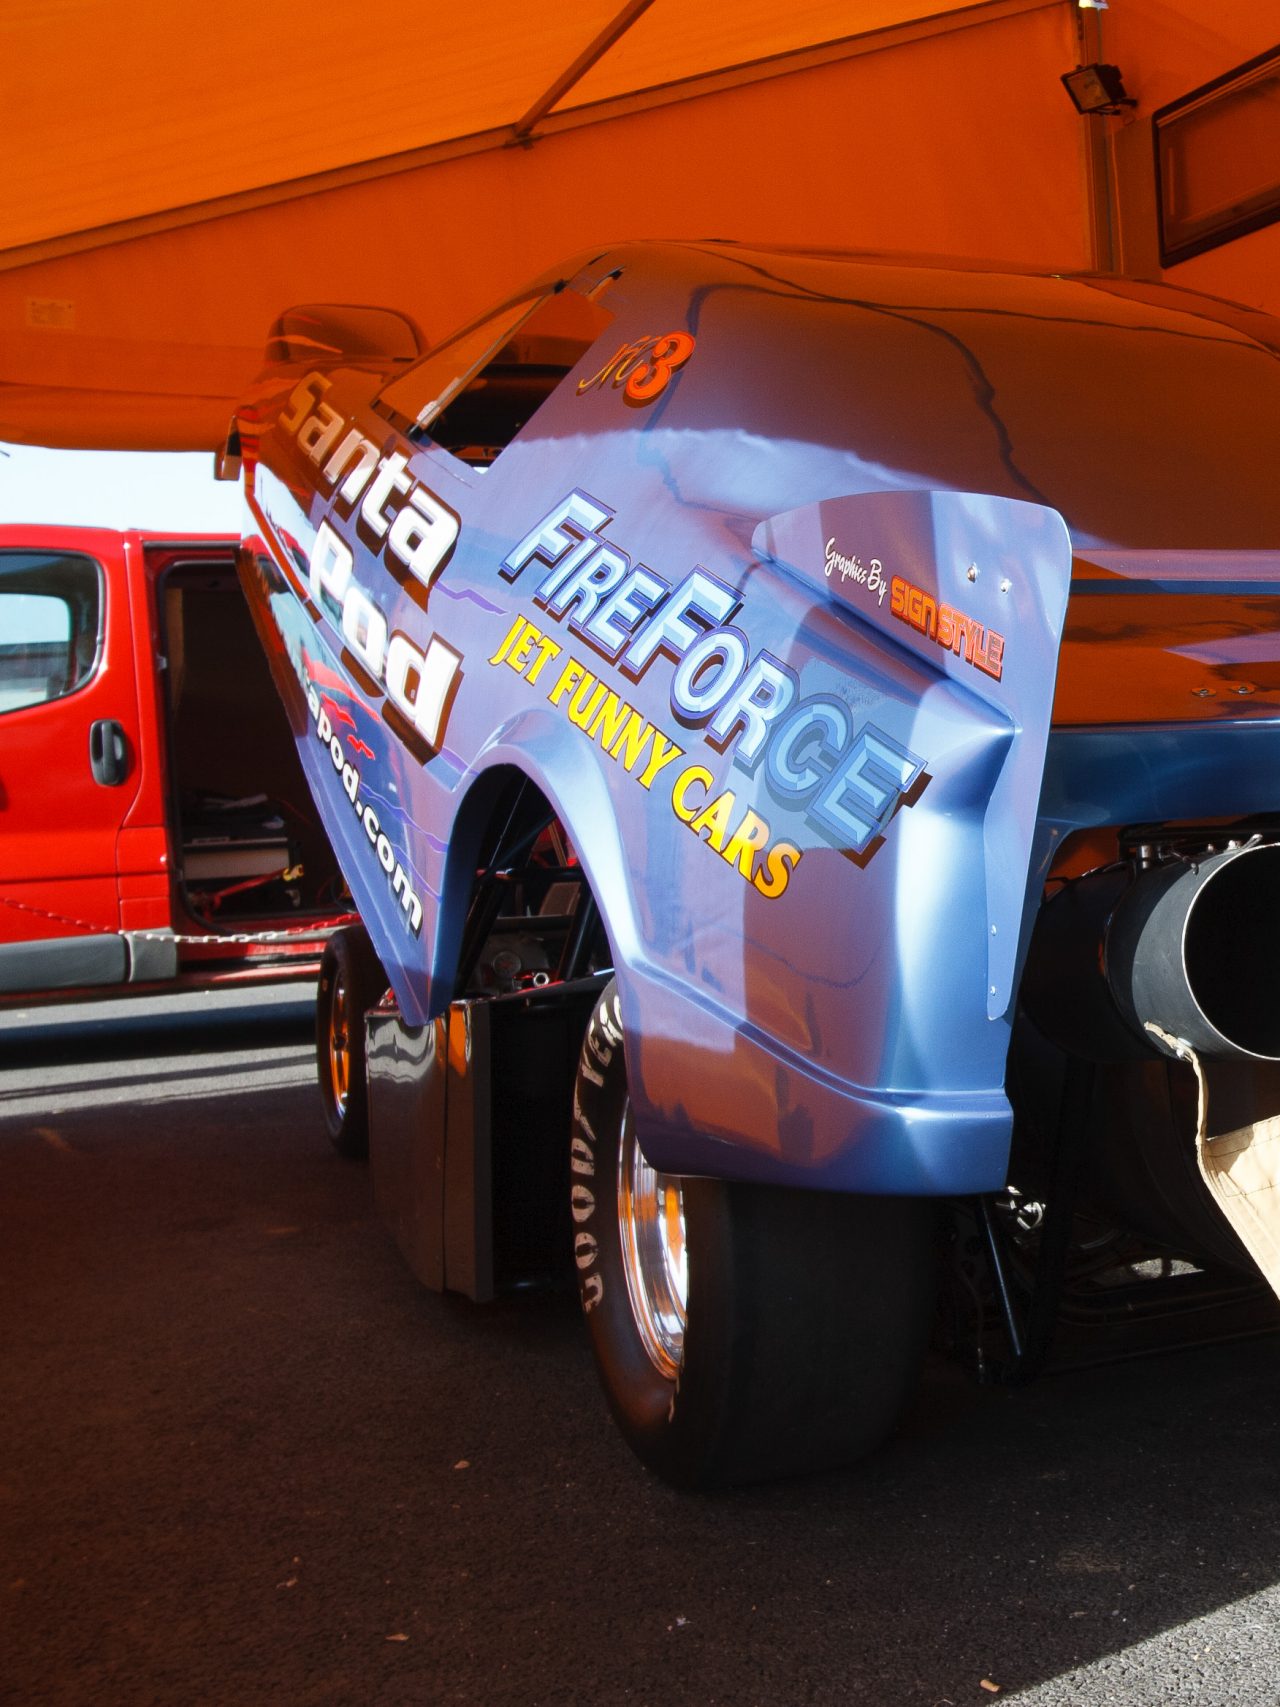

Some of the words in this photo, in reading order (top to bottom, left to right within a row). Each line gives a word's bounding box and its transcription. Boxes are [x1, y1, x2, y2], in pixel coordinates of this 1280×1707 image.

[278, 370, 462, 591] Santa
[824, 536, 868, 585] Graphics
[867, 558, 888, 607] By
[309, 519, 462, 750] Pod
[488, 613, 563, 687] JET
[546, 655, 687, 792] FUNNY
[671, 764, 805, 900] CARS
